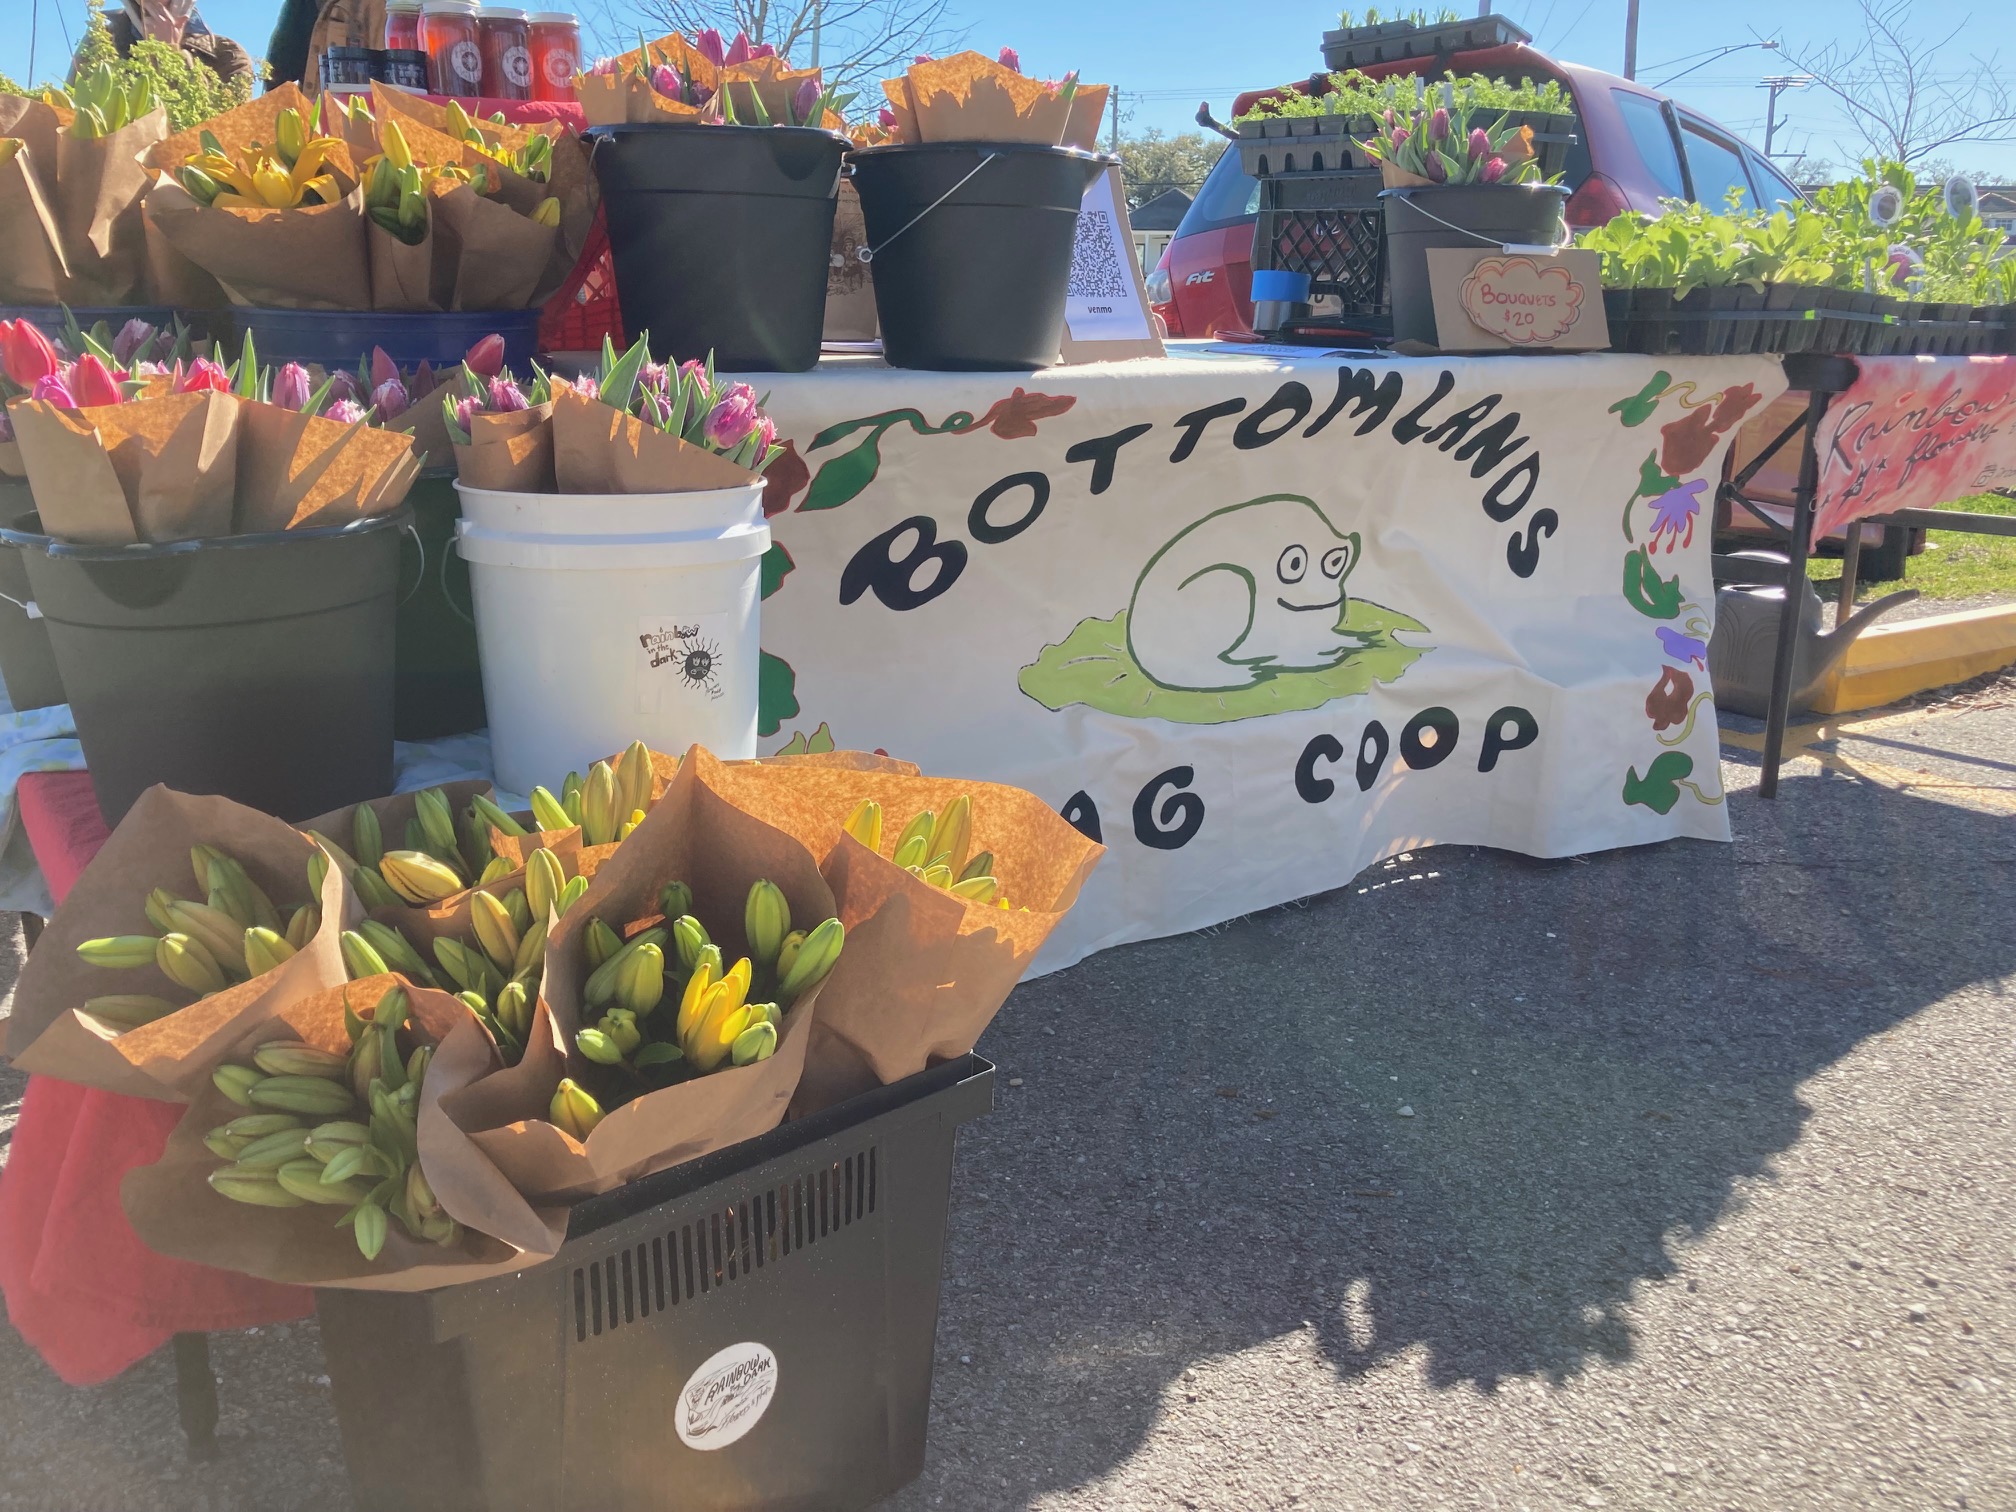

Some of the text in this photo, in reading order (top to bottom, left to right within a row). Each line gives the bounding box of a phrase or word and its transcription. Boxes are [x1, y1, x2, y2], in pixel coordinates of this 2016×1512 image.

[1186, 270, 1215, 286] Fit
[1481, 283, 1556, 306] BOUQUETS
[1087, 306, 1113, 314] venmo
[1504, 308, 1535, 327] $20
[640, 624, 700, 648] rainbow
[650, 648, 678, 668] dark
[657, 644, 670, 652] the
[1295, 705, 1539, 803] COOP
[704, 1353, 760, 1406] RAINBOW
[743, 1356, 771, 1386] DARK
